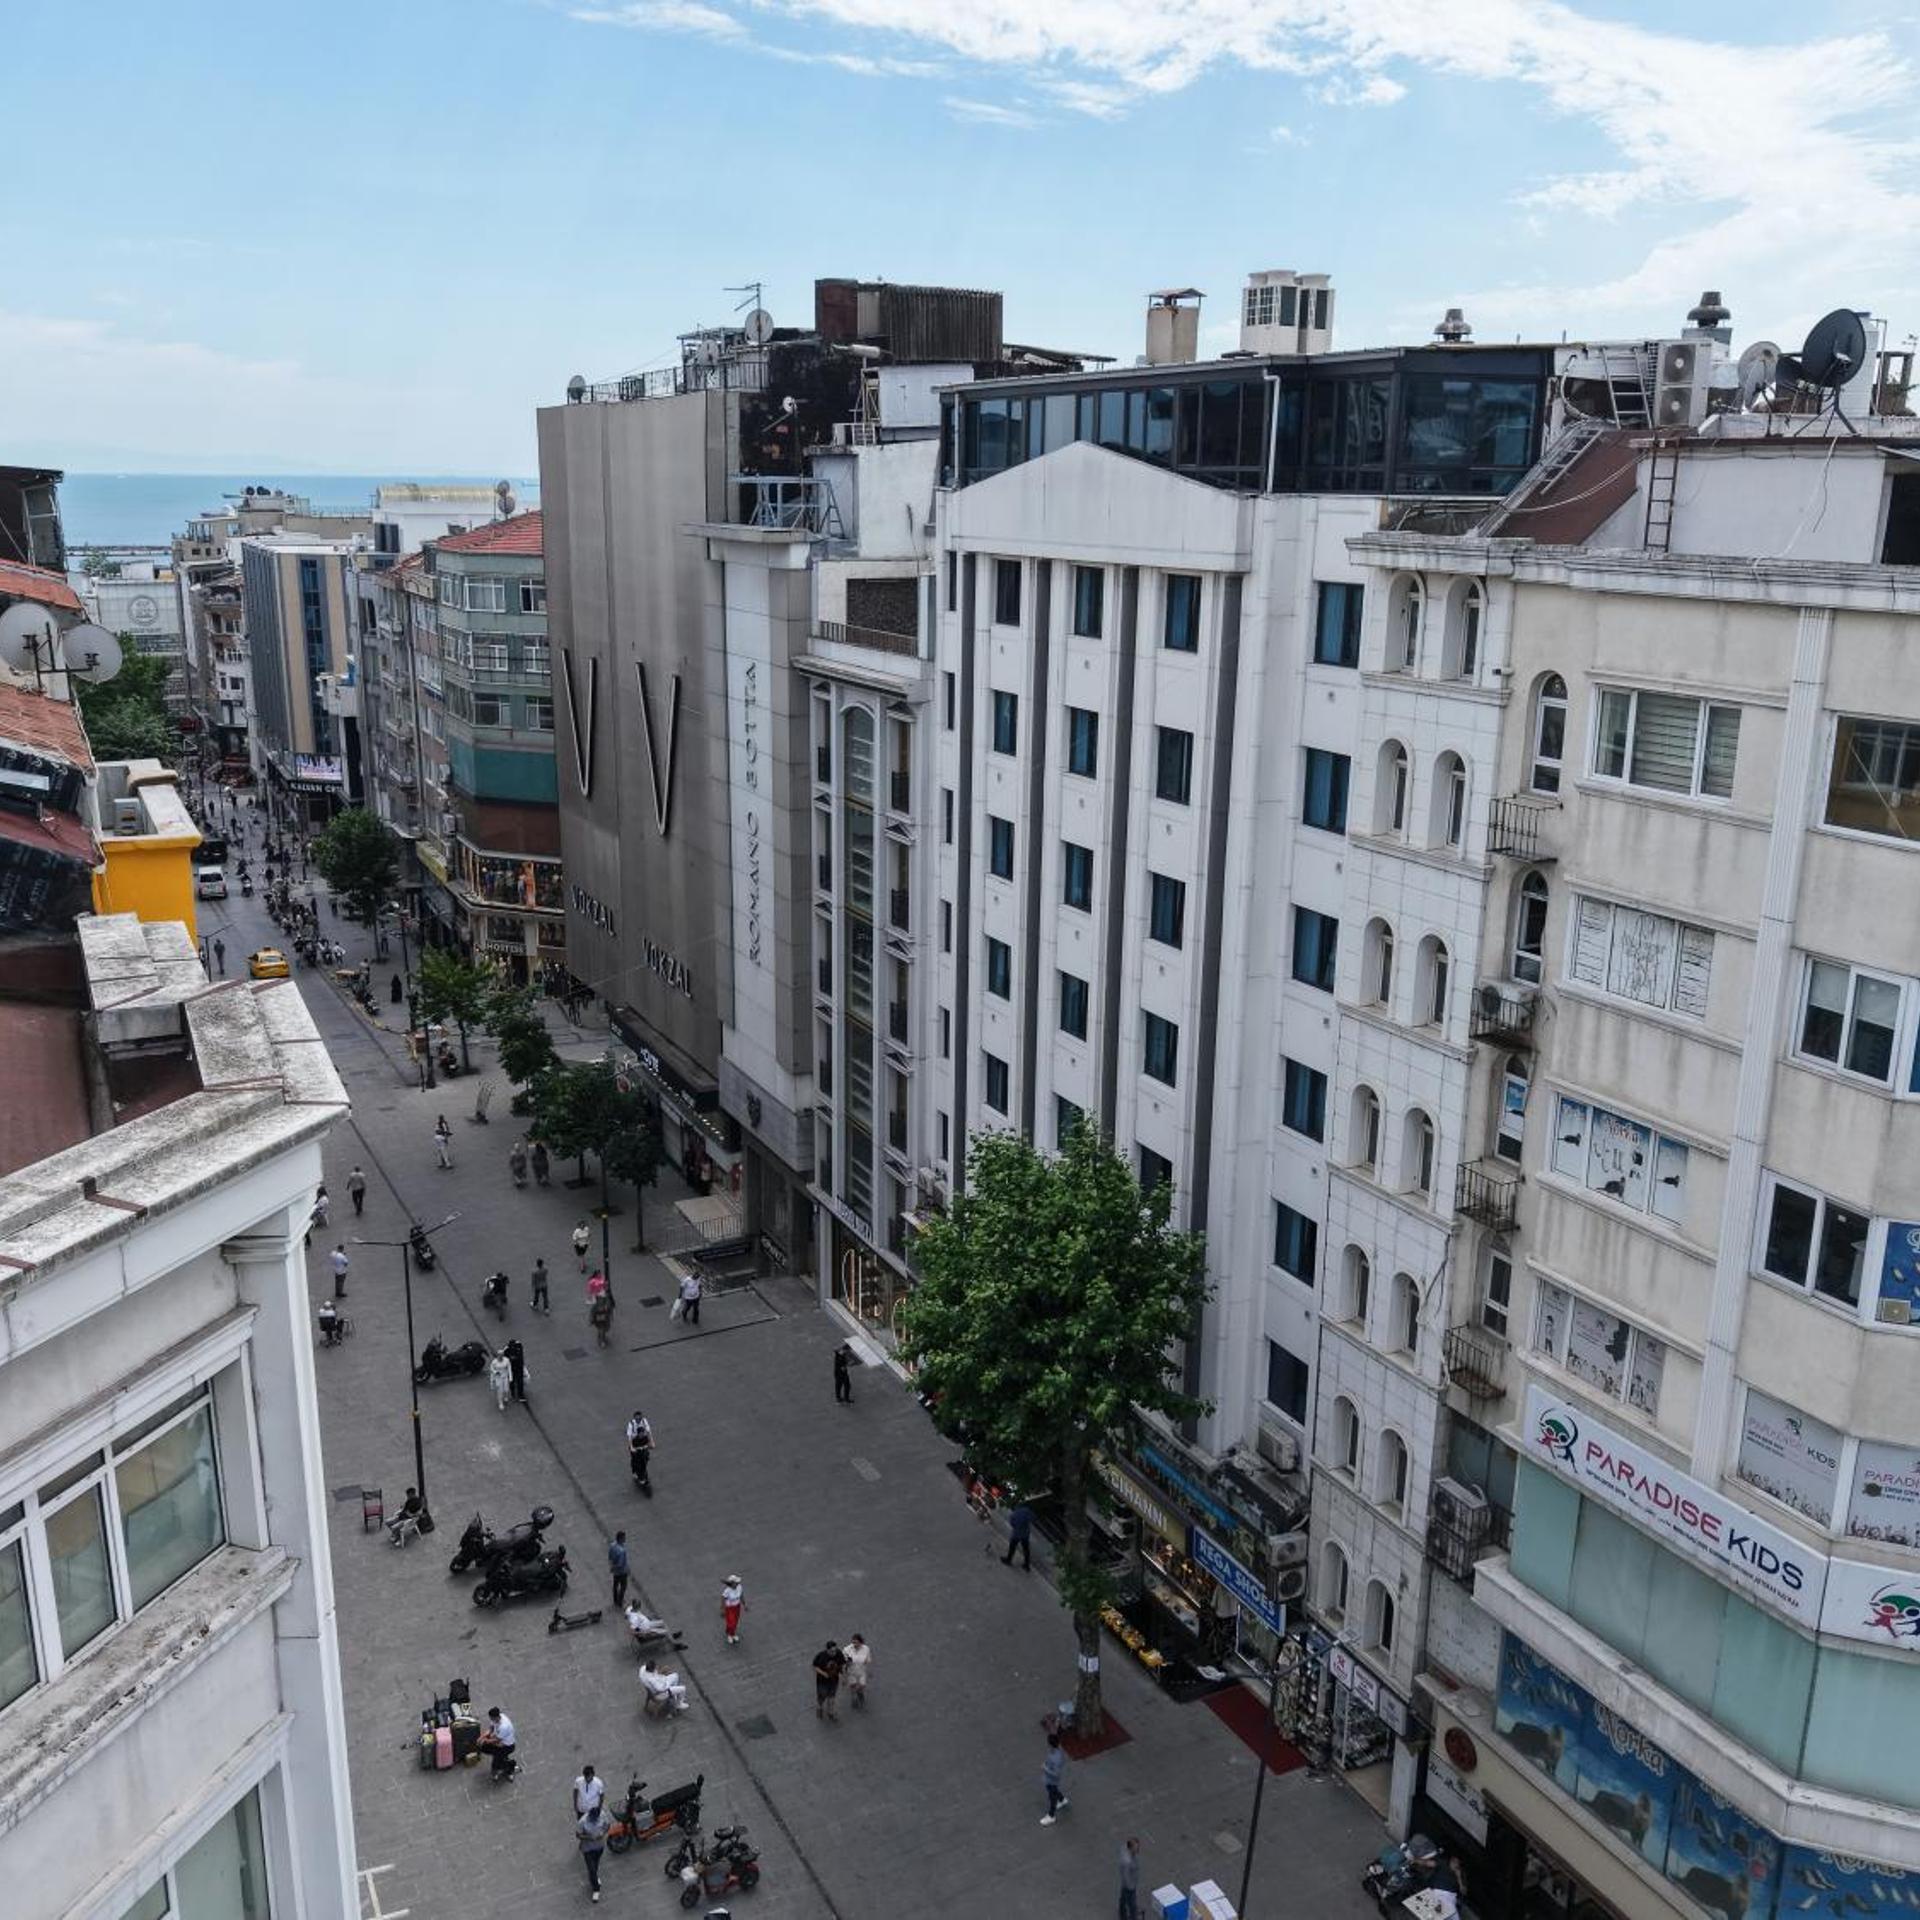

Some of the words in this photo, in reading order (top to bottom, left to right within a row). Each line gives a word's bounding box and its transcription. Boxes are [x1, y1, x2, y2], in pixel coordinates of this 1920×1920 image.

[744, 662, 757, 788] BOTTA
[571, 885, 615, 936] VOKZAL
[748, 811, 761, 968] ROMANO
[642, 937, 692, 999] VOKZAL
[1807, 1446, 1837, 1469] KIDS
[1586, 1441, 1722, 1542] PARADISE
[1728, 1529, 1804, 1590] KIDS
[1199, 1538, 1231, 1578] REGA
[1234, 1570, 1275, 1617] SHOES
